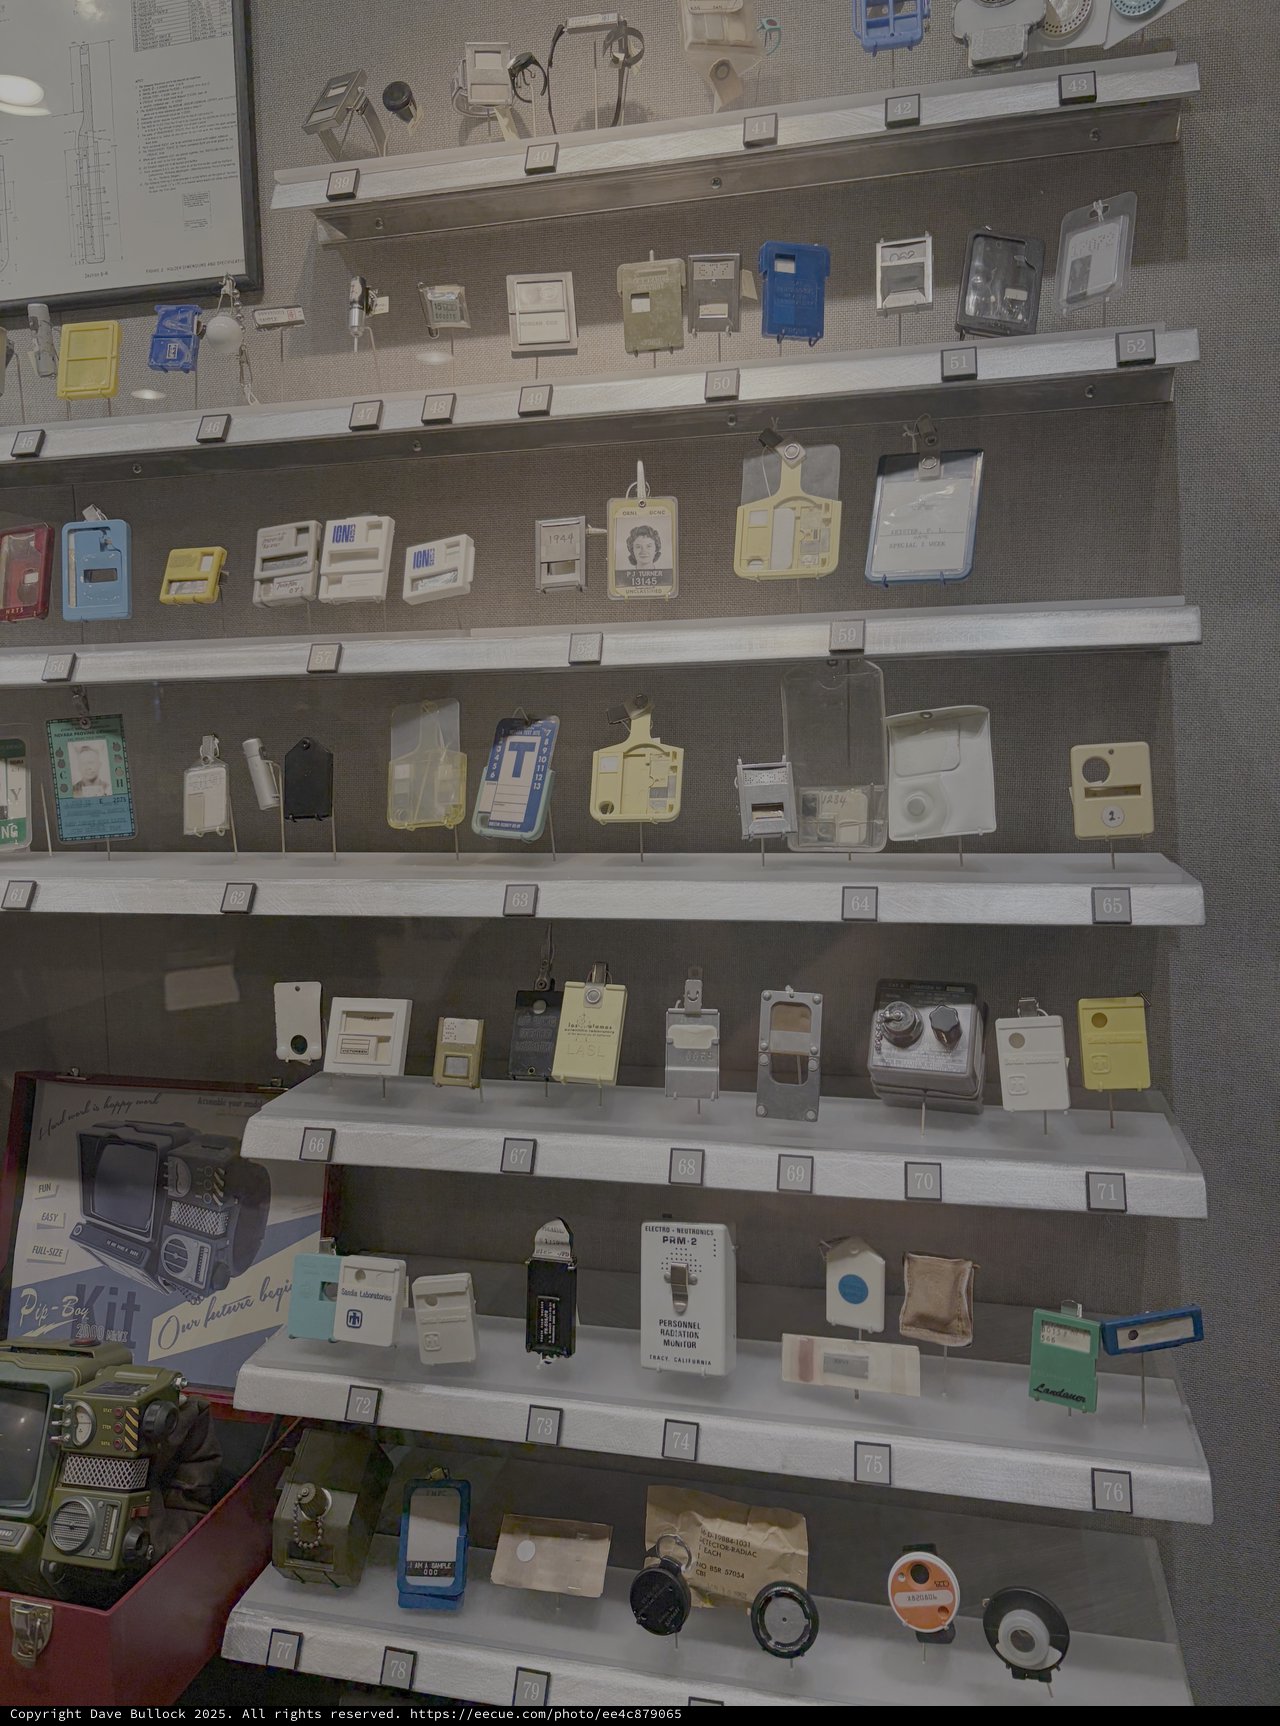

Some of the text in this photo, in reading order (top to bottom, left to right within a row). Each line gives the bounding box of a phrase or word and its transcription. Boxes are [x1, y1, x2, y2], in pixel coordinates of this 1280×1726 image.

[1068, 79, 1087, 92] 43
[894, 102, 912, 115] 42
[752, 120, 767, 132] 41
[535, 149, 549, 163] 40
[335, 176, 350, 189] 39
[1127, 339, 1146, 354] 52
[950, 355, 969, 370] 51
[713, 376, 731, 390] 50
[357, 407, 374, 419] 47
[431, 401, 446, 413] 48
[205, 421, 220, 432] 46
[20, 437, 33, 449] 45
[549, 532, 574, 545] 1944
[631, 577, 657, 586] 13145
[839, 627, 856, 642] 59
[316, 650, 331, 664] 57
[545, 729, 551, 737] 7
[544, 738, 550, 746] 8
[508, 741, 537, 779] T
[538, 755, 547, 763] 10
[490, 771, 495, 779] 6
[537, 764, 545, 772] 11
[535, 773, 542, 781] 12
[533, 782, 541, 790] 13
[11, 888, 24, 902] 61
[230, 890, 245, 905] 62
[512, 892, 528, 907] 63
[851, 895, 870, 911] 64
[1102, 897, 1122, 913] 65
[567, 1044, 606, 1058] LASL
[104, 1095, 133, 1115] happy
[309, 1137, 325, 1153] 66
[510, 1147, 528, 1165] 67
[678, 1158, 695, 1176] 68
[787, 1164, 804, 1182] 69
[38, 1183, 52, 1193] FUN
[914, 1172, 933, 1190] 70
[1096, 1183, 1117, 1201] 71
[41, 1212, 59, 1222] EASY
[645, 1225, 714, 1235] ELECTRO NEUTRONICS
[32, 1245, 64, 1257] FULL-SIZE
[341, 1288, 392, 1302] Sandia Laboratories
[19, 1287, 90, 1328] Pip-Boy
[70, 1283, 141, 1349] Kit
[157, 1314, 201, 1350] Our
[203, 1295, 255, 1328] future
[659, 1318, 702, 1330] PERSONNEL
[75, 1322, 105, 1341] 2000
[660, 1328, 700, 1339] RADIATION
[663, 1339, 696, 1349] MONITOR
[673, 1357, 712, 1366] CALIFORNIA
[1033, 1383, 1086, 1403] Landauer
[355, 1396, 371, 1414] 72
[536, 1417, 553, 1436] 73
[672, 1431, 690, 1451] 74
[864, 1454, 883, 1474] 75
[1103, 1481, 1123, 1502] 76
[703, 1547, 722, 1558] EACH
[696, 1561, 707, 1569] NO
[725, 1569, 745, 1579] 57054
[277, 1641, 291, 1660] 77
[391, 1660, 407, 1680] 78
[523, 1681, 540, 1701] 79
